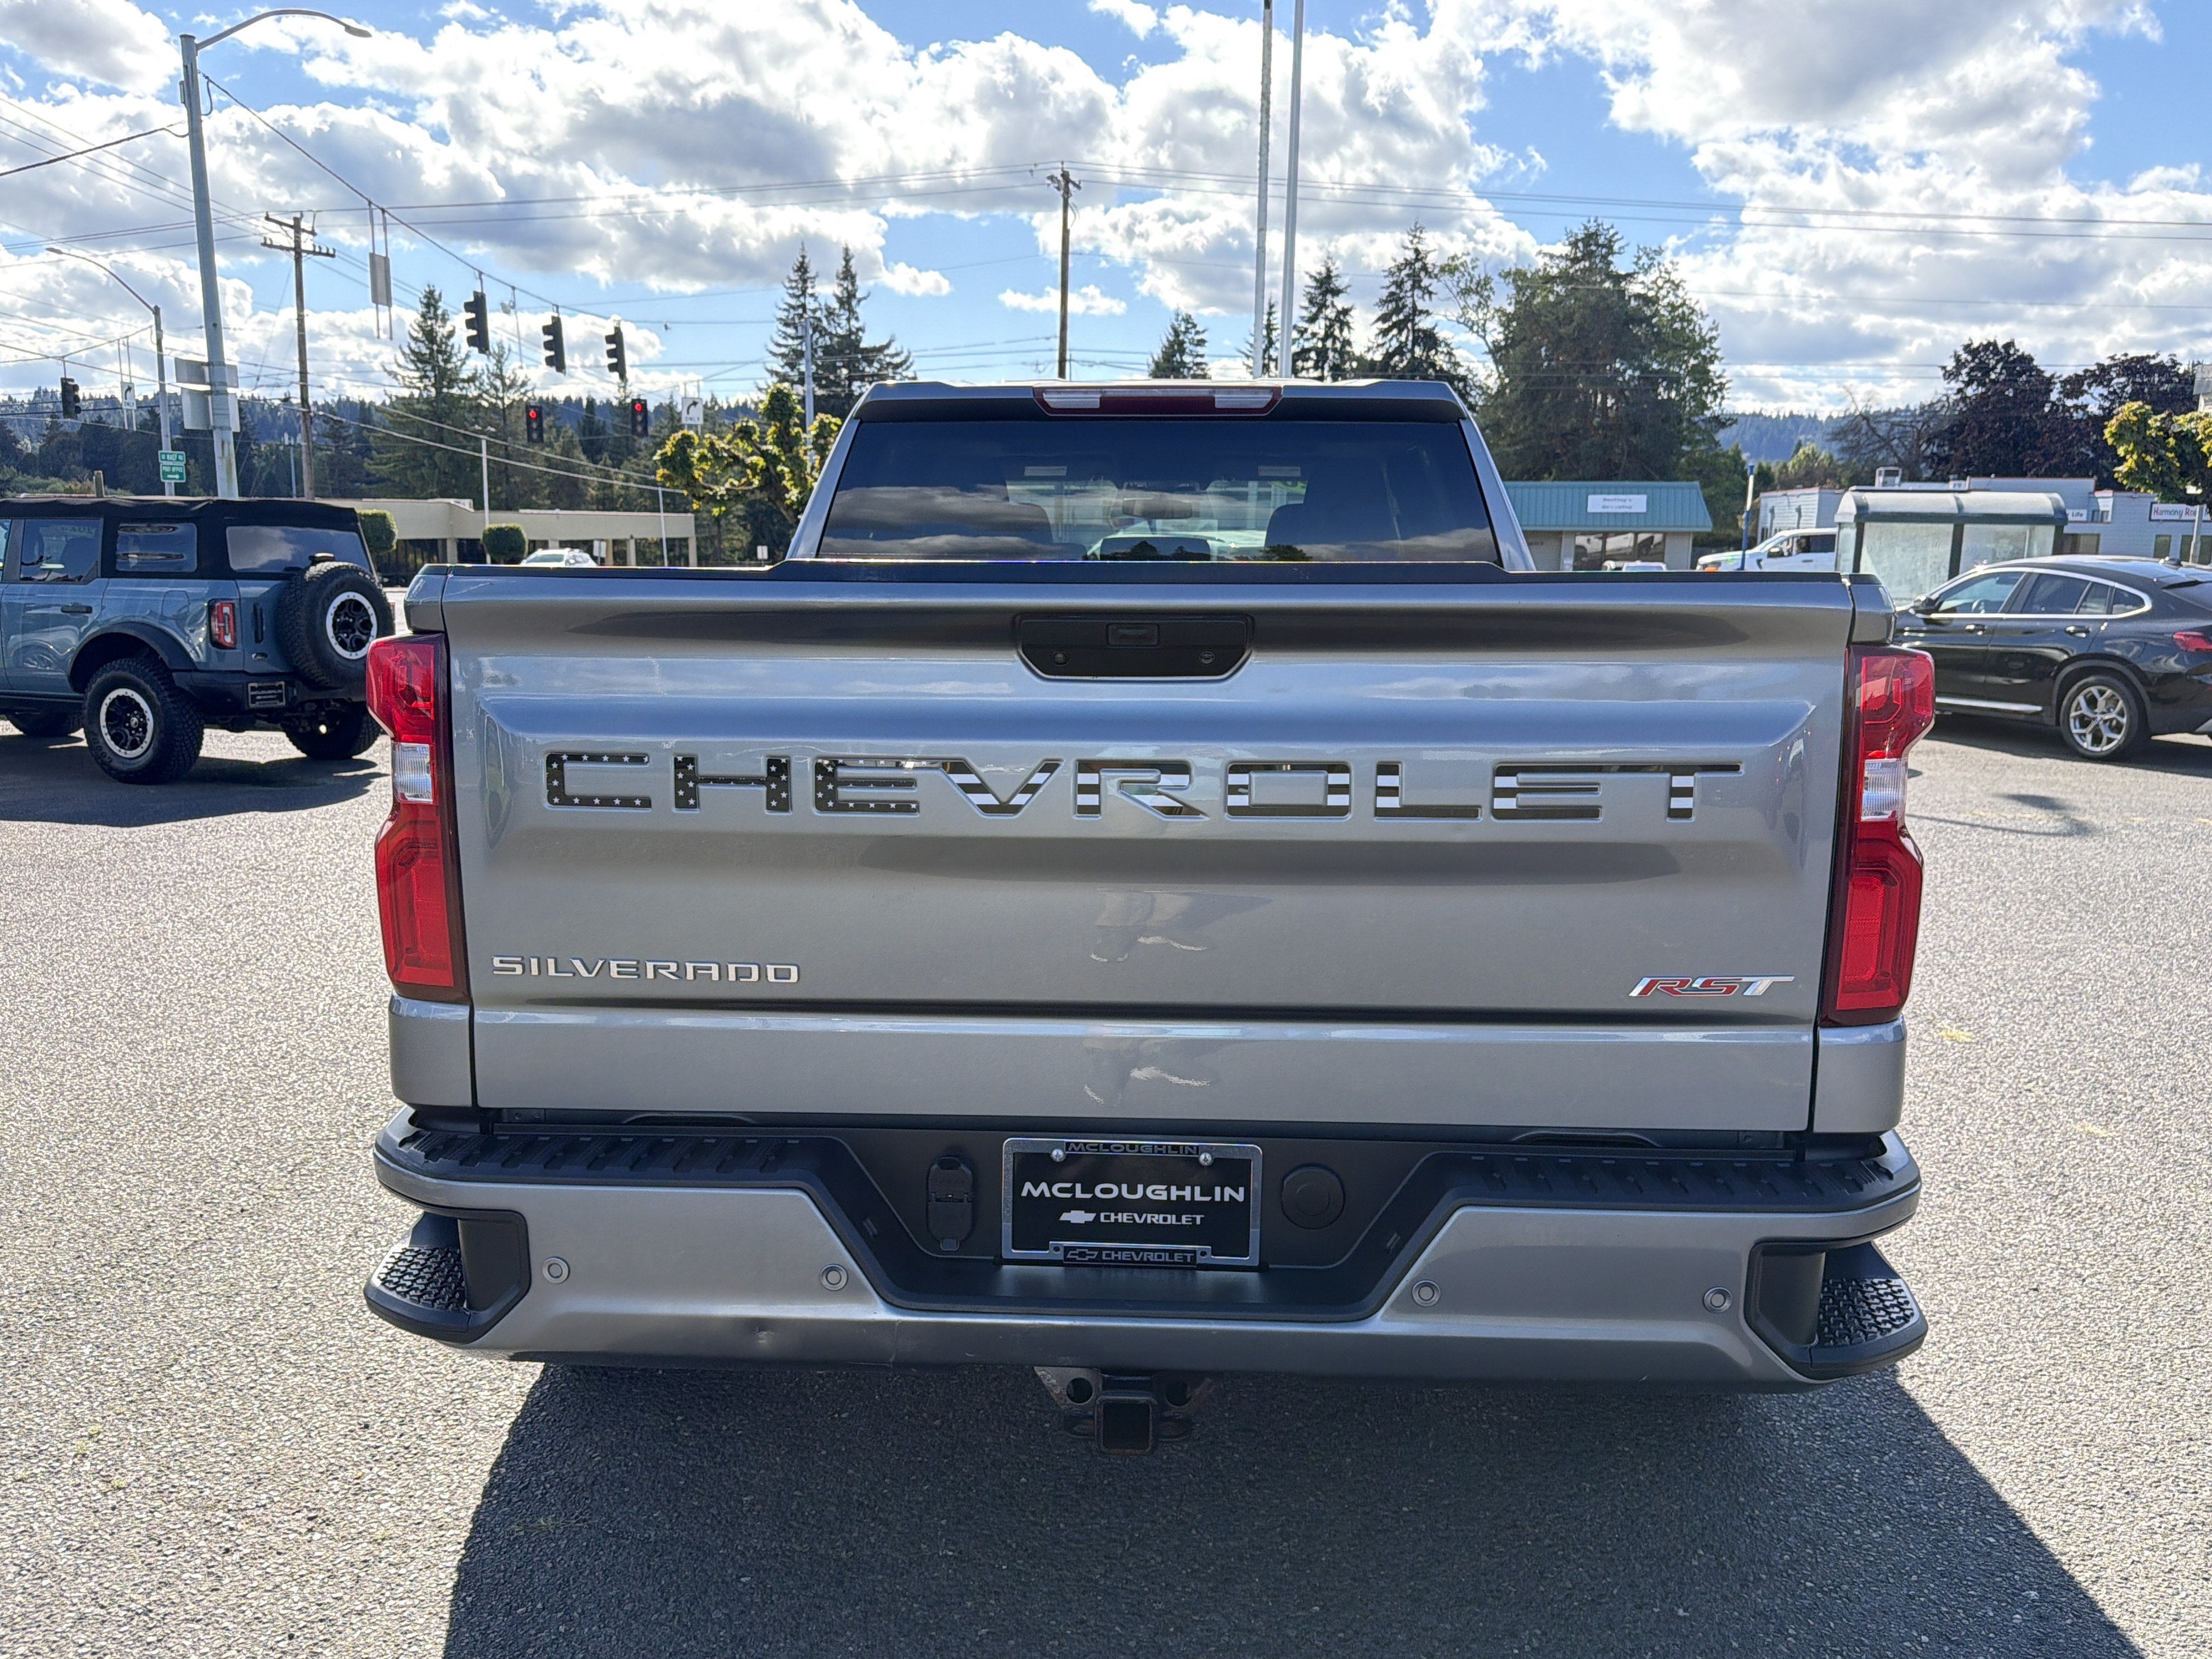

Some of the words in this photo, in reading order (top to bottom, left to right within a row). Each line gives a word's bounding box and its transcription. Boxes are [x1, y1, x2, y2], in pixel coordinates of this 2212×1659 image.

[2153, 507, 2183, 520] Harmony
[545, 752, 1742, 820] CHEVROLET
[492, 956, 799, 983] SILVERADO
[1628, 976, 1795, 997] RST
[1068, 1143, 1197, 1155] MCLOUGHLIN
[1020, 1181, 1245, 1202] MCLOUGHLIN
[1100, 1212, 1204, 1225] CHEVROLET
[1102, 1250, 1194, 1262] CHEVROLET
